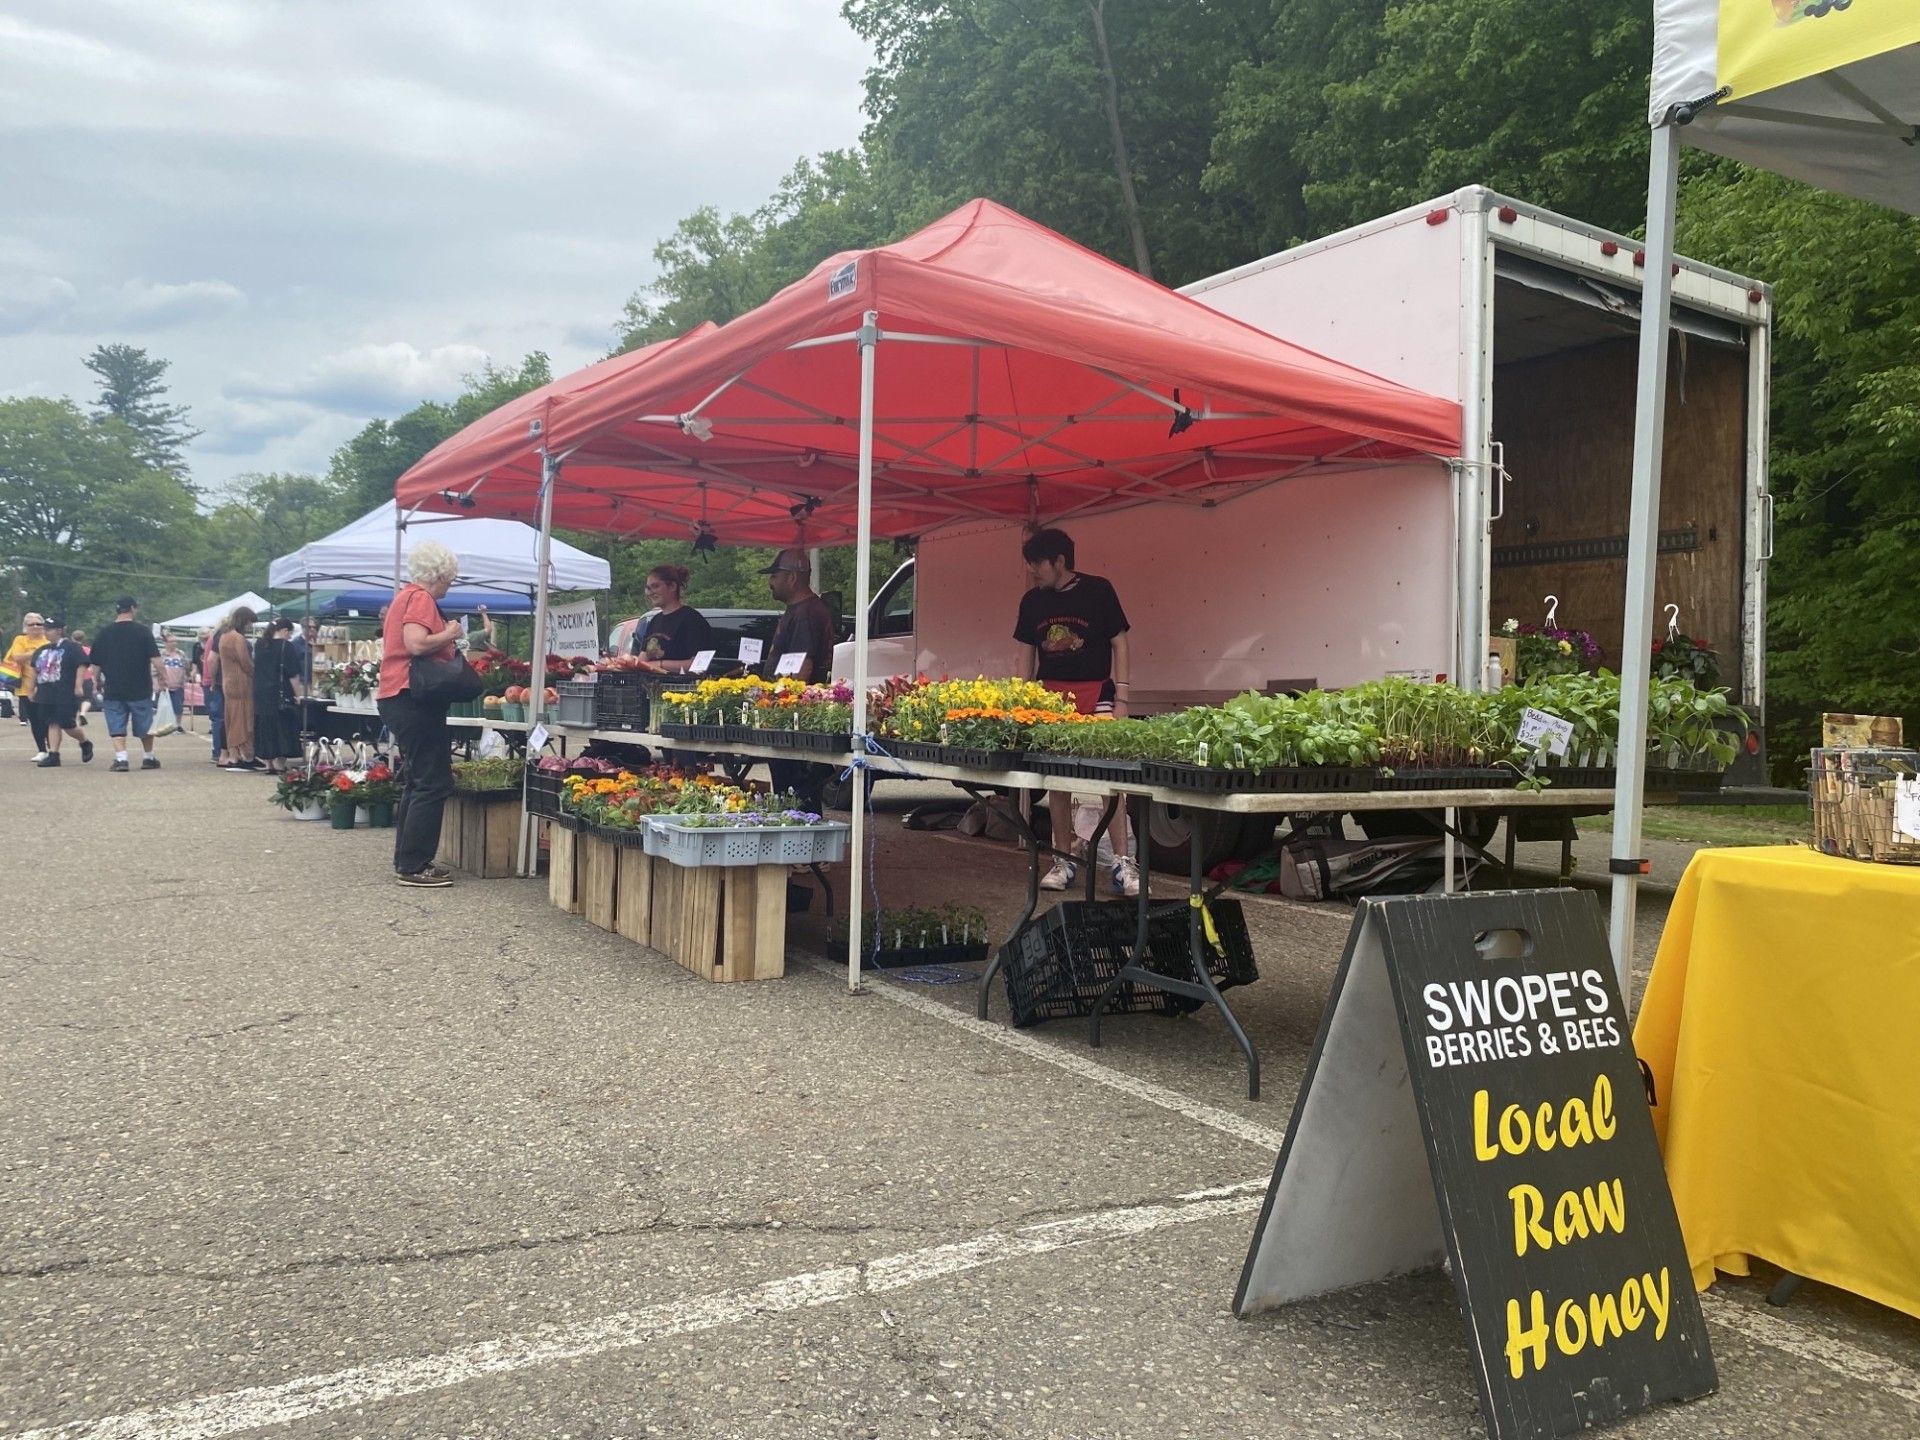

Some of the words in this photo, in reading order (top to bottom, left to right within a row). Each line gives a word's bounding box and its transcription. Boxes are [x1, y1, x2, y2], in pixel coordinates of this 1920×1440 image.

[1423, 969, 1609, 1031] SWOPE'S
[1425, 1025, 1532, 1068] BERRIES
[1538, 1022, 1561, 1055] &
[1563, 1016, 1621, 1051] BEES
[1473, 1074, 1617, 1162] Local
[1508, 1178, 1626, 1257] Raw
[1505, 1267, 1669, 1379] Honey
